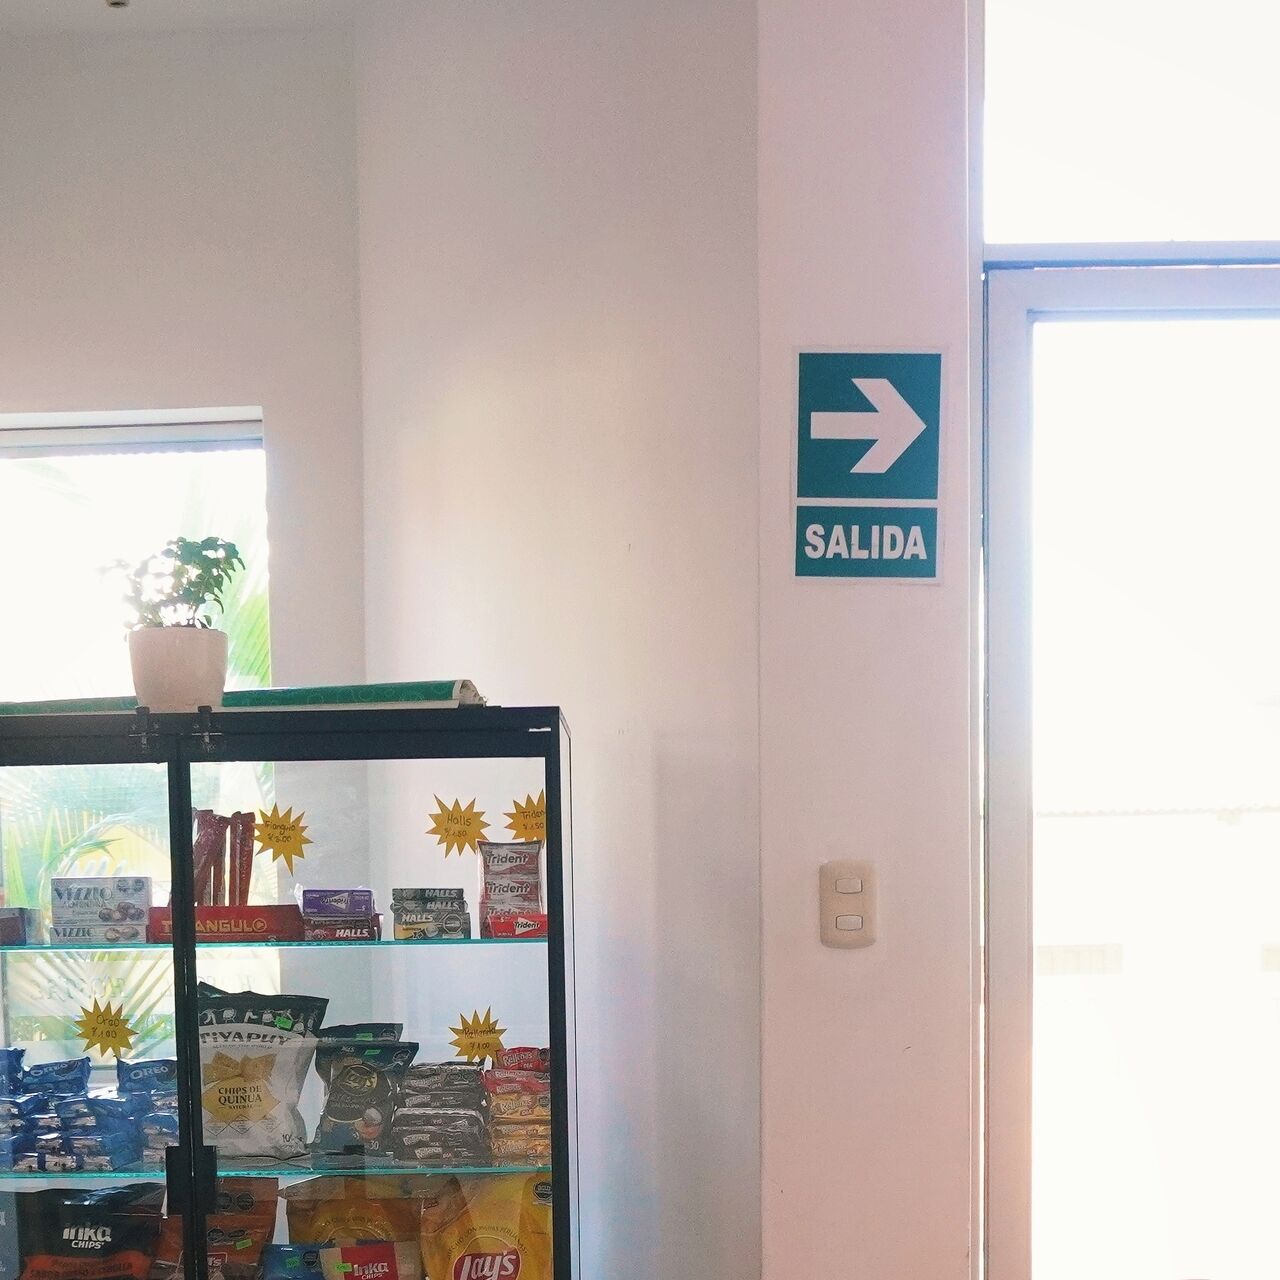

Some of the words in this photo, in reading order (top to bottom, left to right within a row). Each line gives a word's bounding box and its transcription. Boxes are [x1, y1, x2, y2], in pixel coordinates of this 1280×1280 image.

[804, 523, 927, 560] SALIDA
[520, 810, 546, 820] Triden
[447, 814, 472, 827] Halls
[486, 850, 529, 865] Trident
[487, 881, 530, 894] Trident
[425, 888, 458, 898] HALLS
[426, 900, 459, 910] HALLS
[402, 914, 434, 923] HALLS
[161, 918, 268, 933] TANGULO
[514, 921, 540, 930] Trident
[335, 929, 370, 938] HALLS
[96, 1014, 120, 1028] Oreo
[129, 1065, 169, 1080] OREO
[218, 1086, 247, 1095] CHIPS
[249, 1085, 262, 1093] DE
[218, 1094, 262, 1105] QUINUA
[71, 1240, 104, 1249] CHIPS
[361, 1272, 383, 1280] CHIPS
